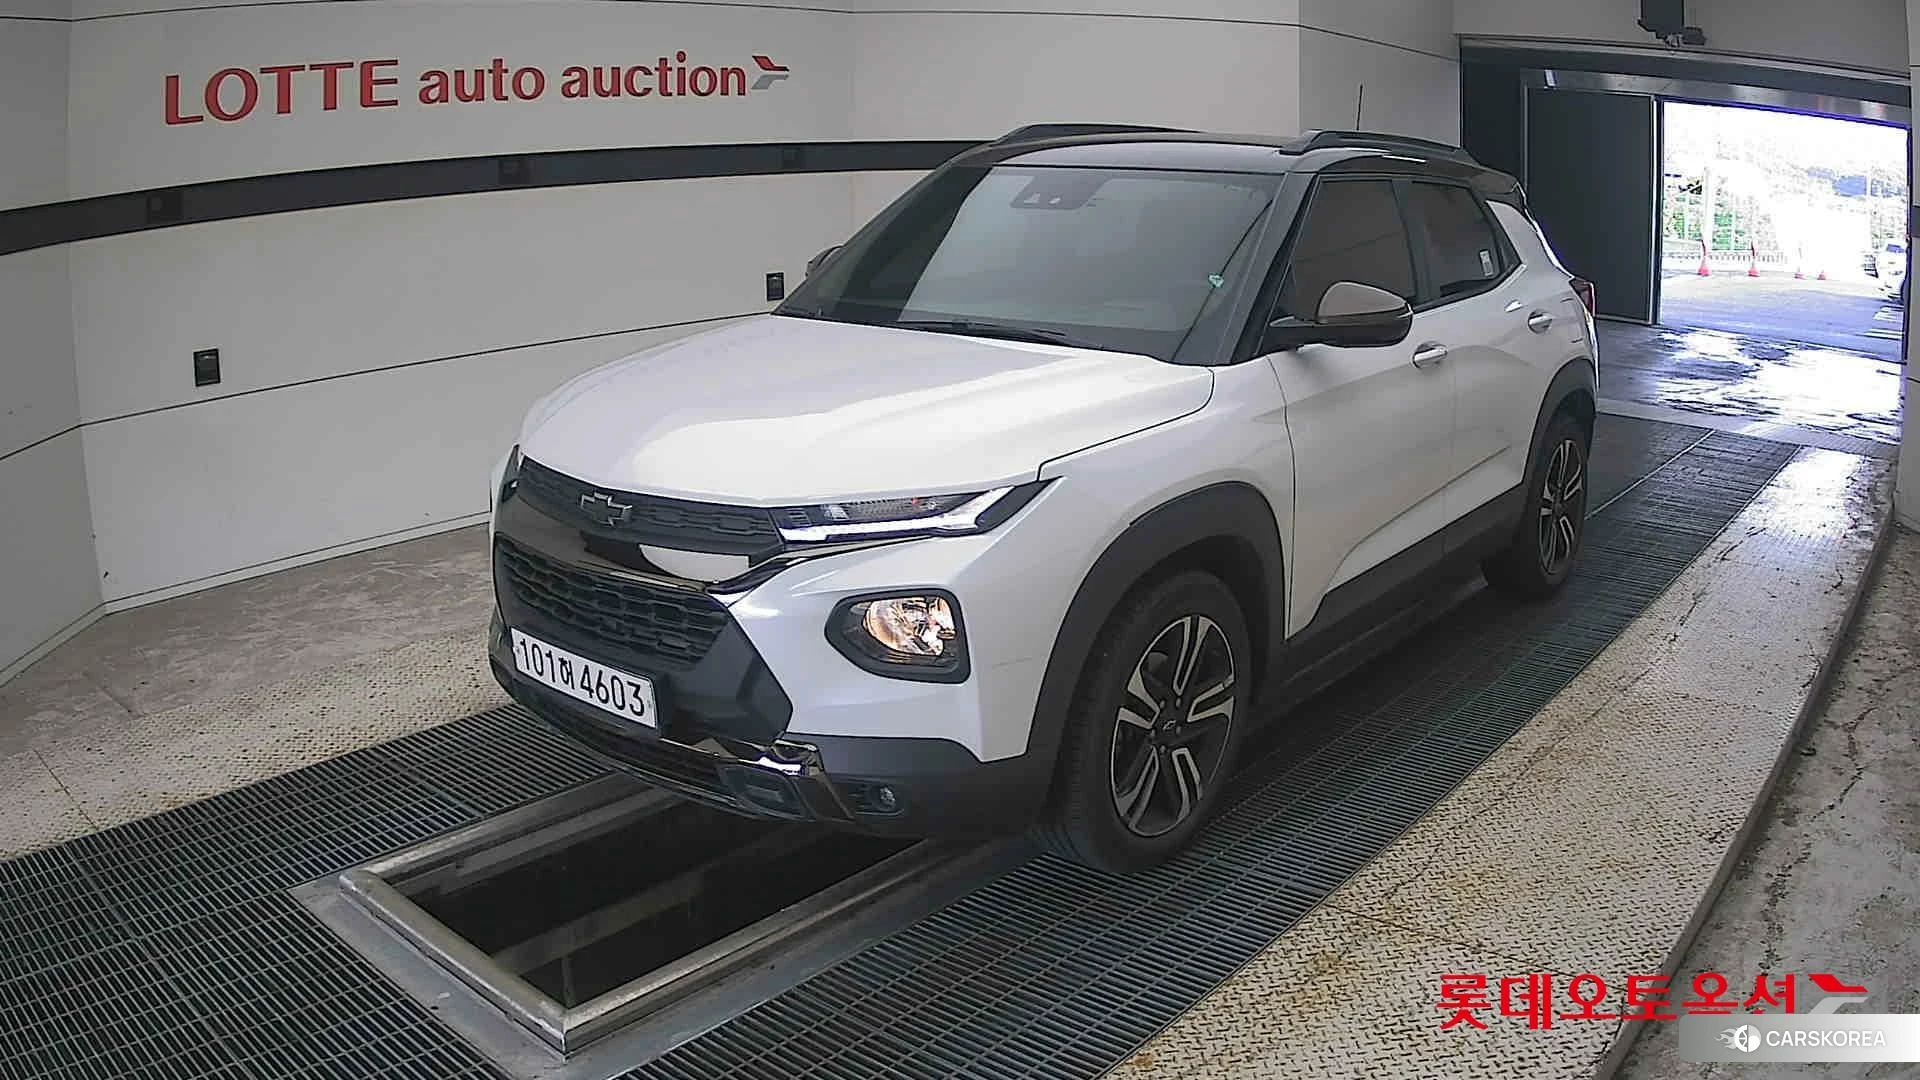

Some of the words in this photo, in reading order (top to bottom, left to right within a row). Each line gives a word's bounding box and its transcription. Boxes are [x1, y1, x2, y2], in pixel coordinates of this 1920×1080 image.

[165, 59, 399, 125] LOTTE
[418, 58, 546, 105] auto
[560, 51, 748, 98] auction
[520, 638, 645, 717] 101허4603
